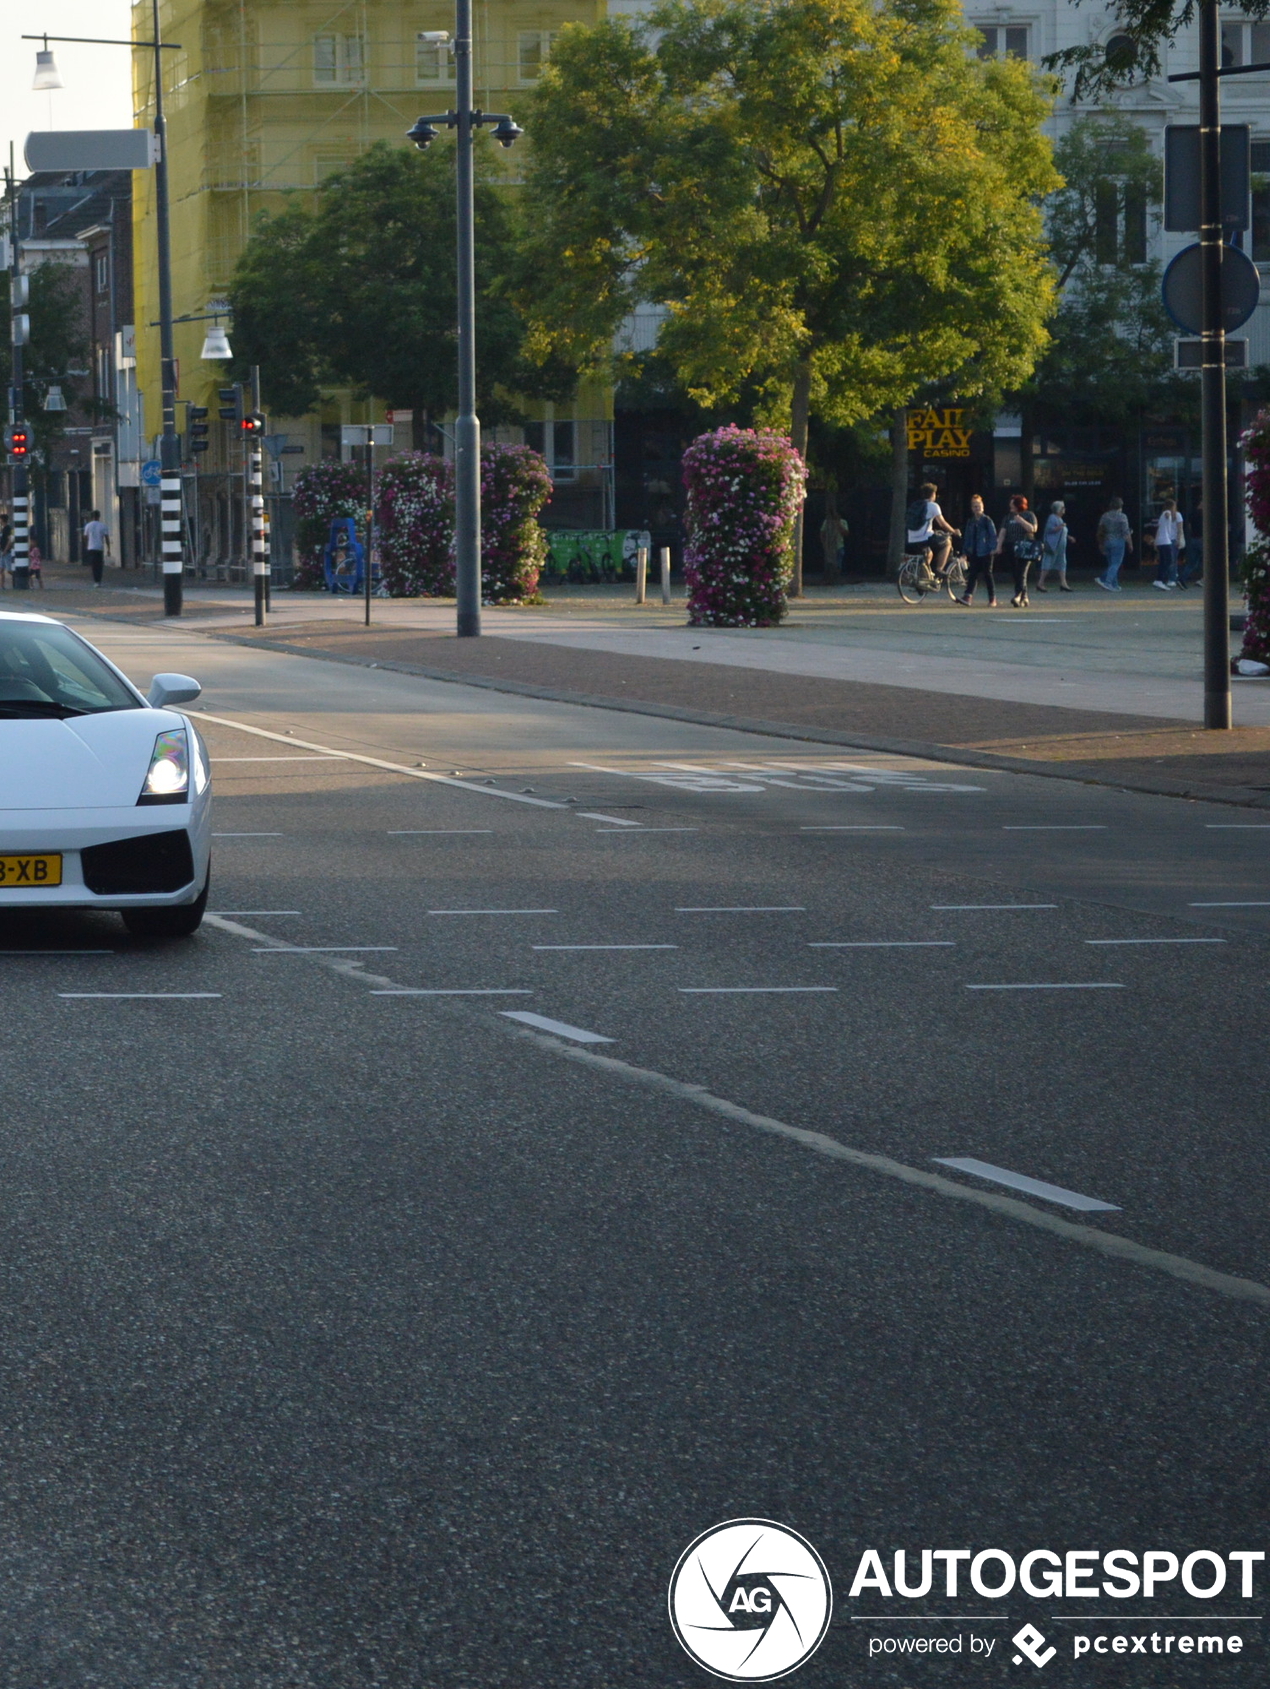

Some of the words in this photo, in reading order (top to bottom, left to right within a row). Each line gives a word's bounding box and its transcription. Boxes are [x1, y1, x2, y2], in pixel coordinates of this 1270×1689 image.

[908, 429, 973, 450] PLAY
[923, 449, 971, 458] CASINO
[632, 775, 989, 793] BUS
